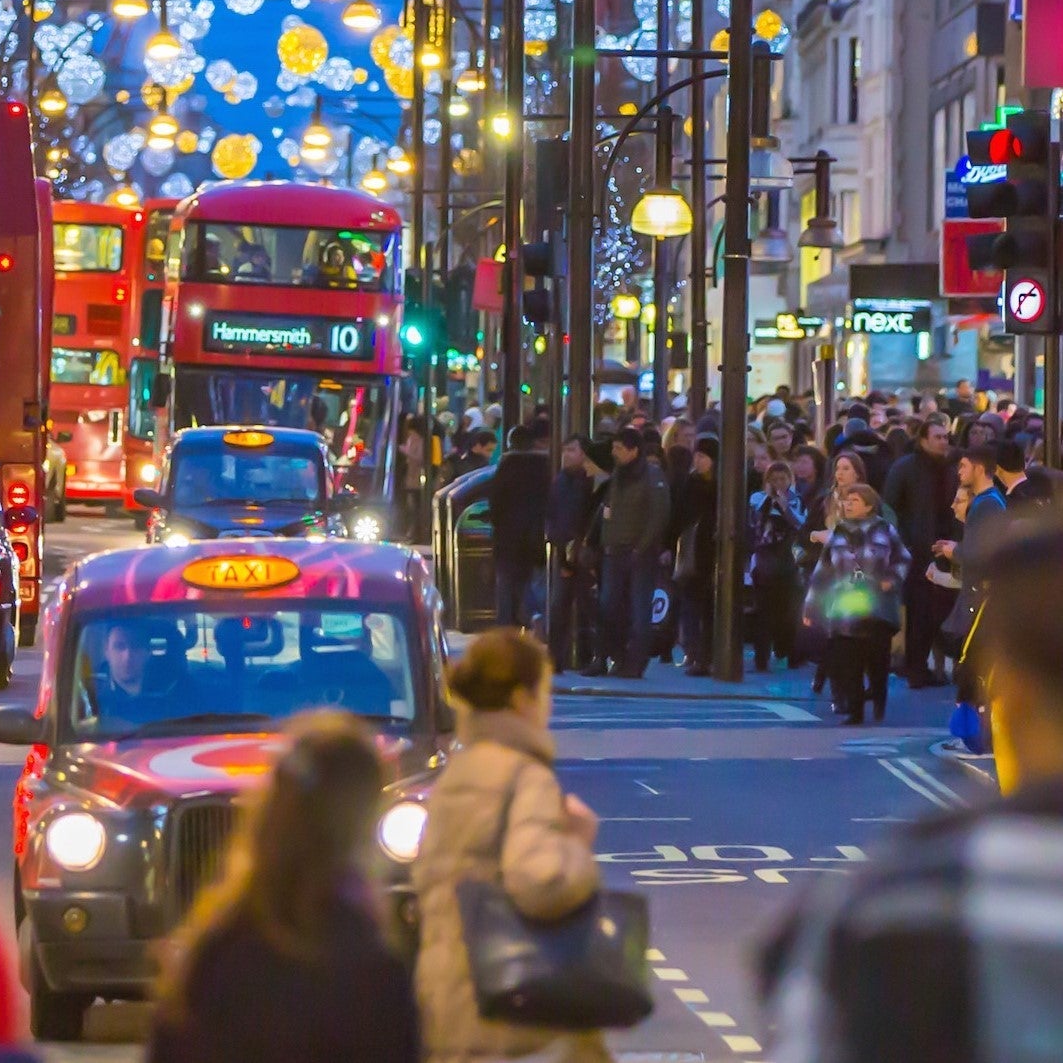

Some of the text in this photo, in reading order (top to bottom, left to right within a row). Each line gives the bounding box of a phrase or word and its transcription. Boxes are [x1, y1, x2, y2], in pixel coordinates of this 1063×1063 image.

[853, 311, 914, 334] next
[212, 321, 360, 353] Hammersmith 10
[207, 562, 271, 583] TAXI
